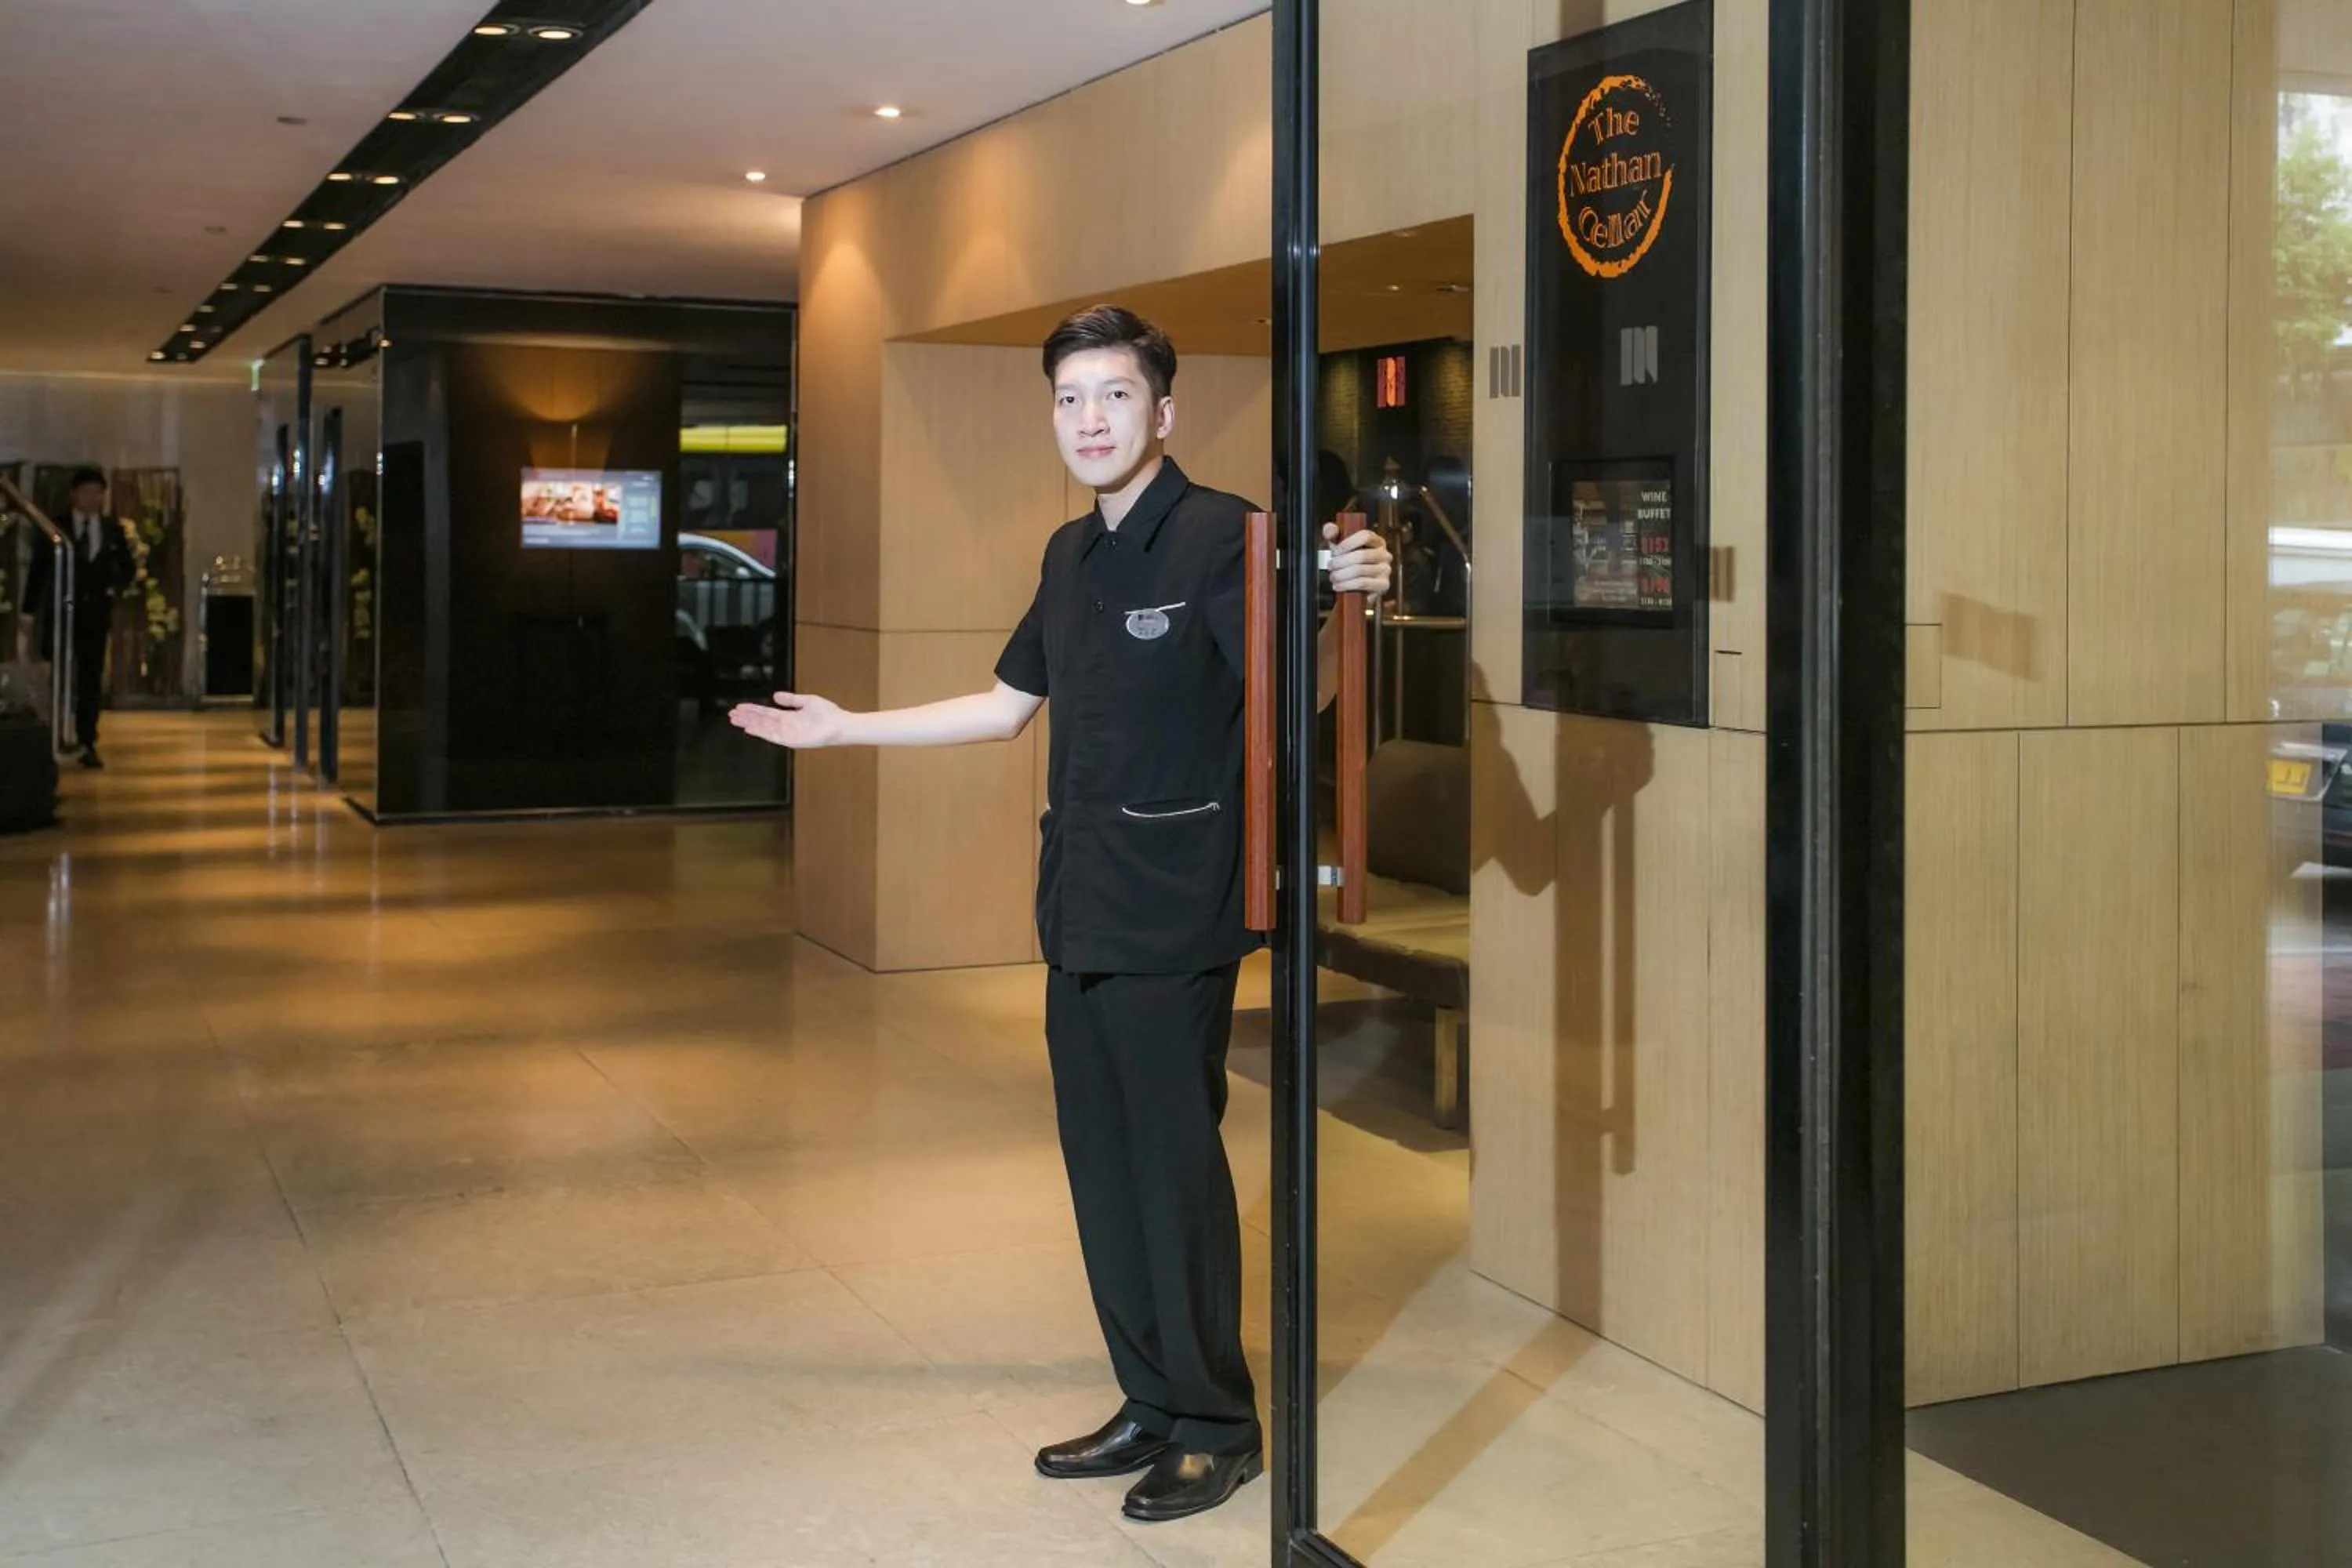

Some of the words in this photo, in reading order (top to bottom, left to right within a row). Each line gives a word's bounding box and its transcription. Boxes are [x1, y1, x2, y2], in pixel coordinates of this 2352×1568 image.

[1588, 107, 1640, 145] The
[1570, 151, 1662, 197] Nathan
[1578, 189, 1651, 249] Cellar
[1637, 508, 1671, 520] BUFFET
[1641, 490, 1668, 503] WINE
